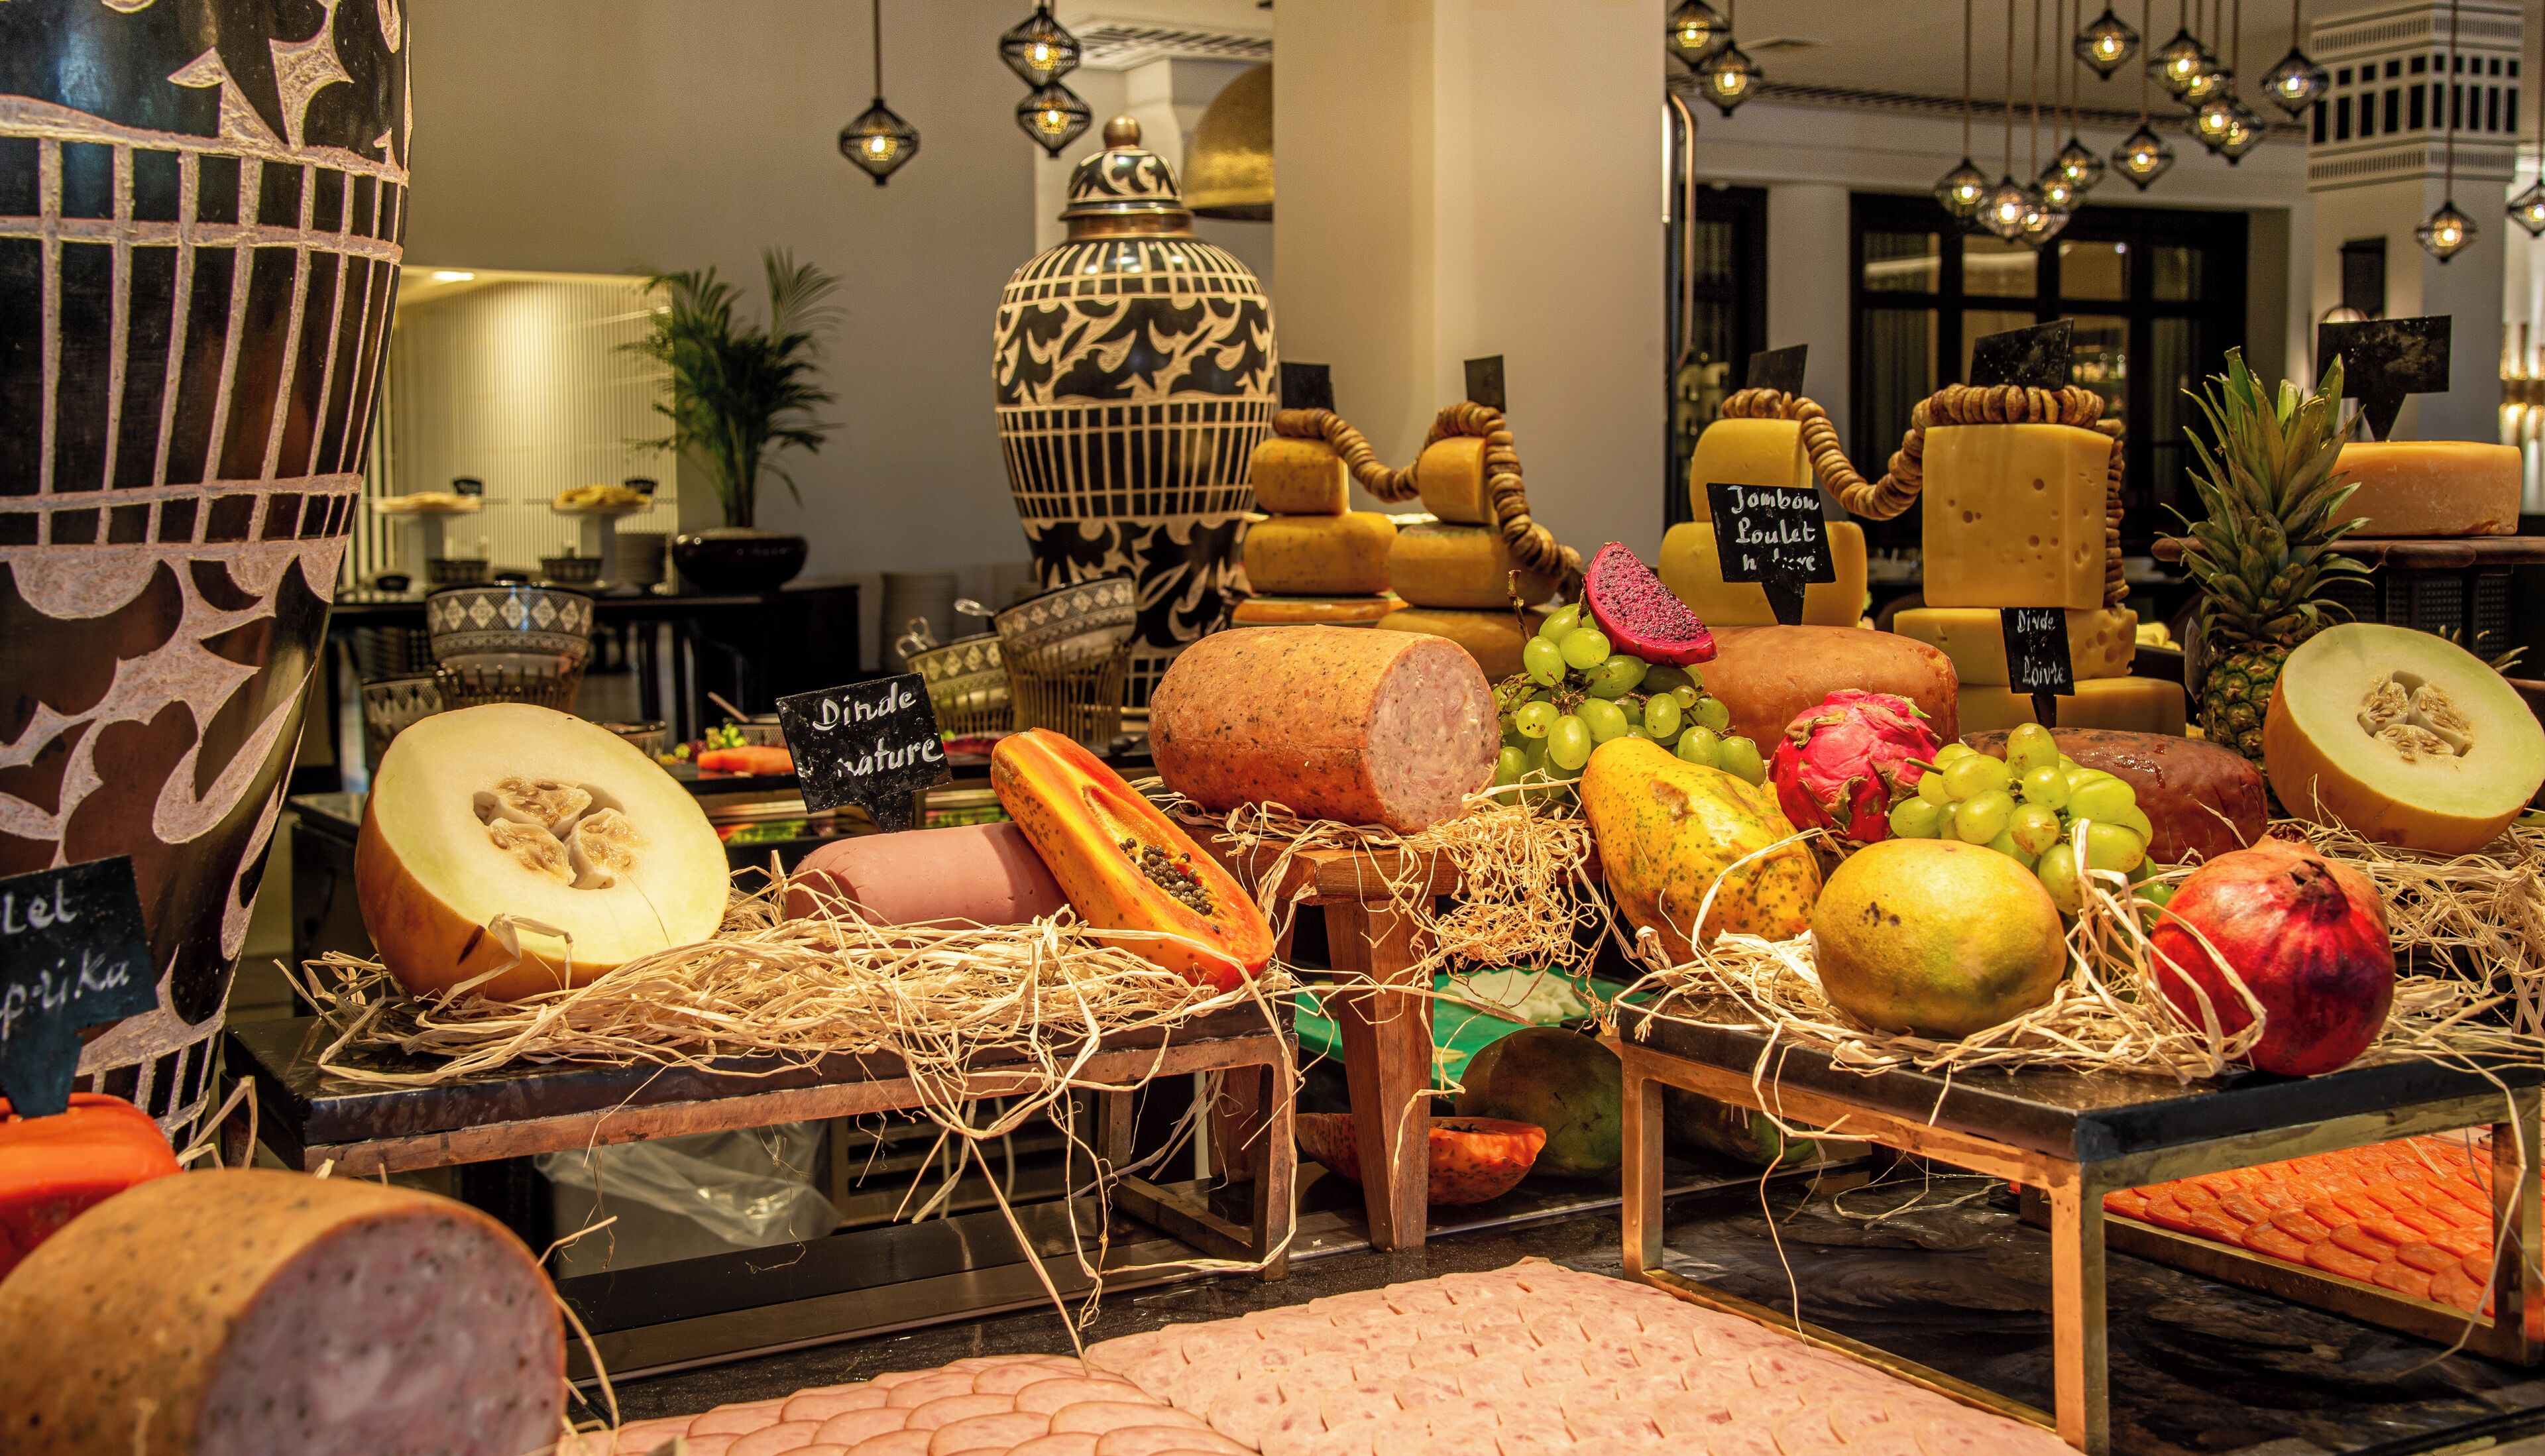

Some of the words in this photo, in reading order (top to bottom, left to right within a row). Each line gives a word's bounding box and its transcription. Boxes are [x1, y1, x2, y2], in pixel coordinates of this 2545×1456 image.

[1736, 517, 1815, 543] Poulet
[813, 682, 917, 731] Dinde
[837, 737, 944, 777] nature
